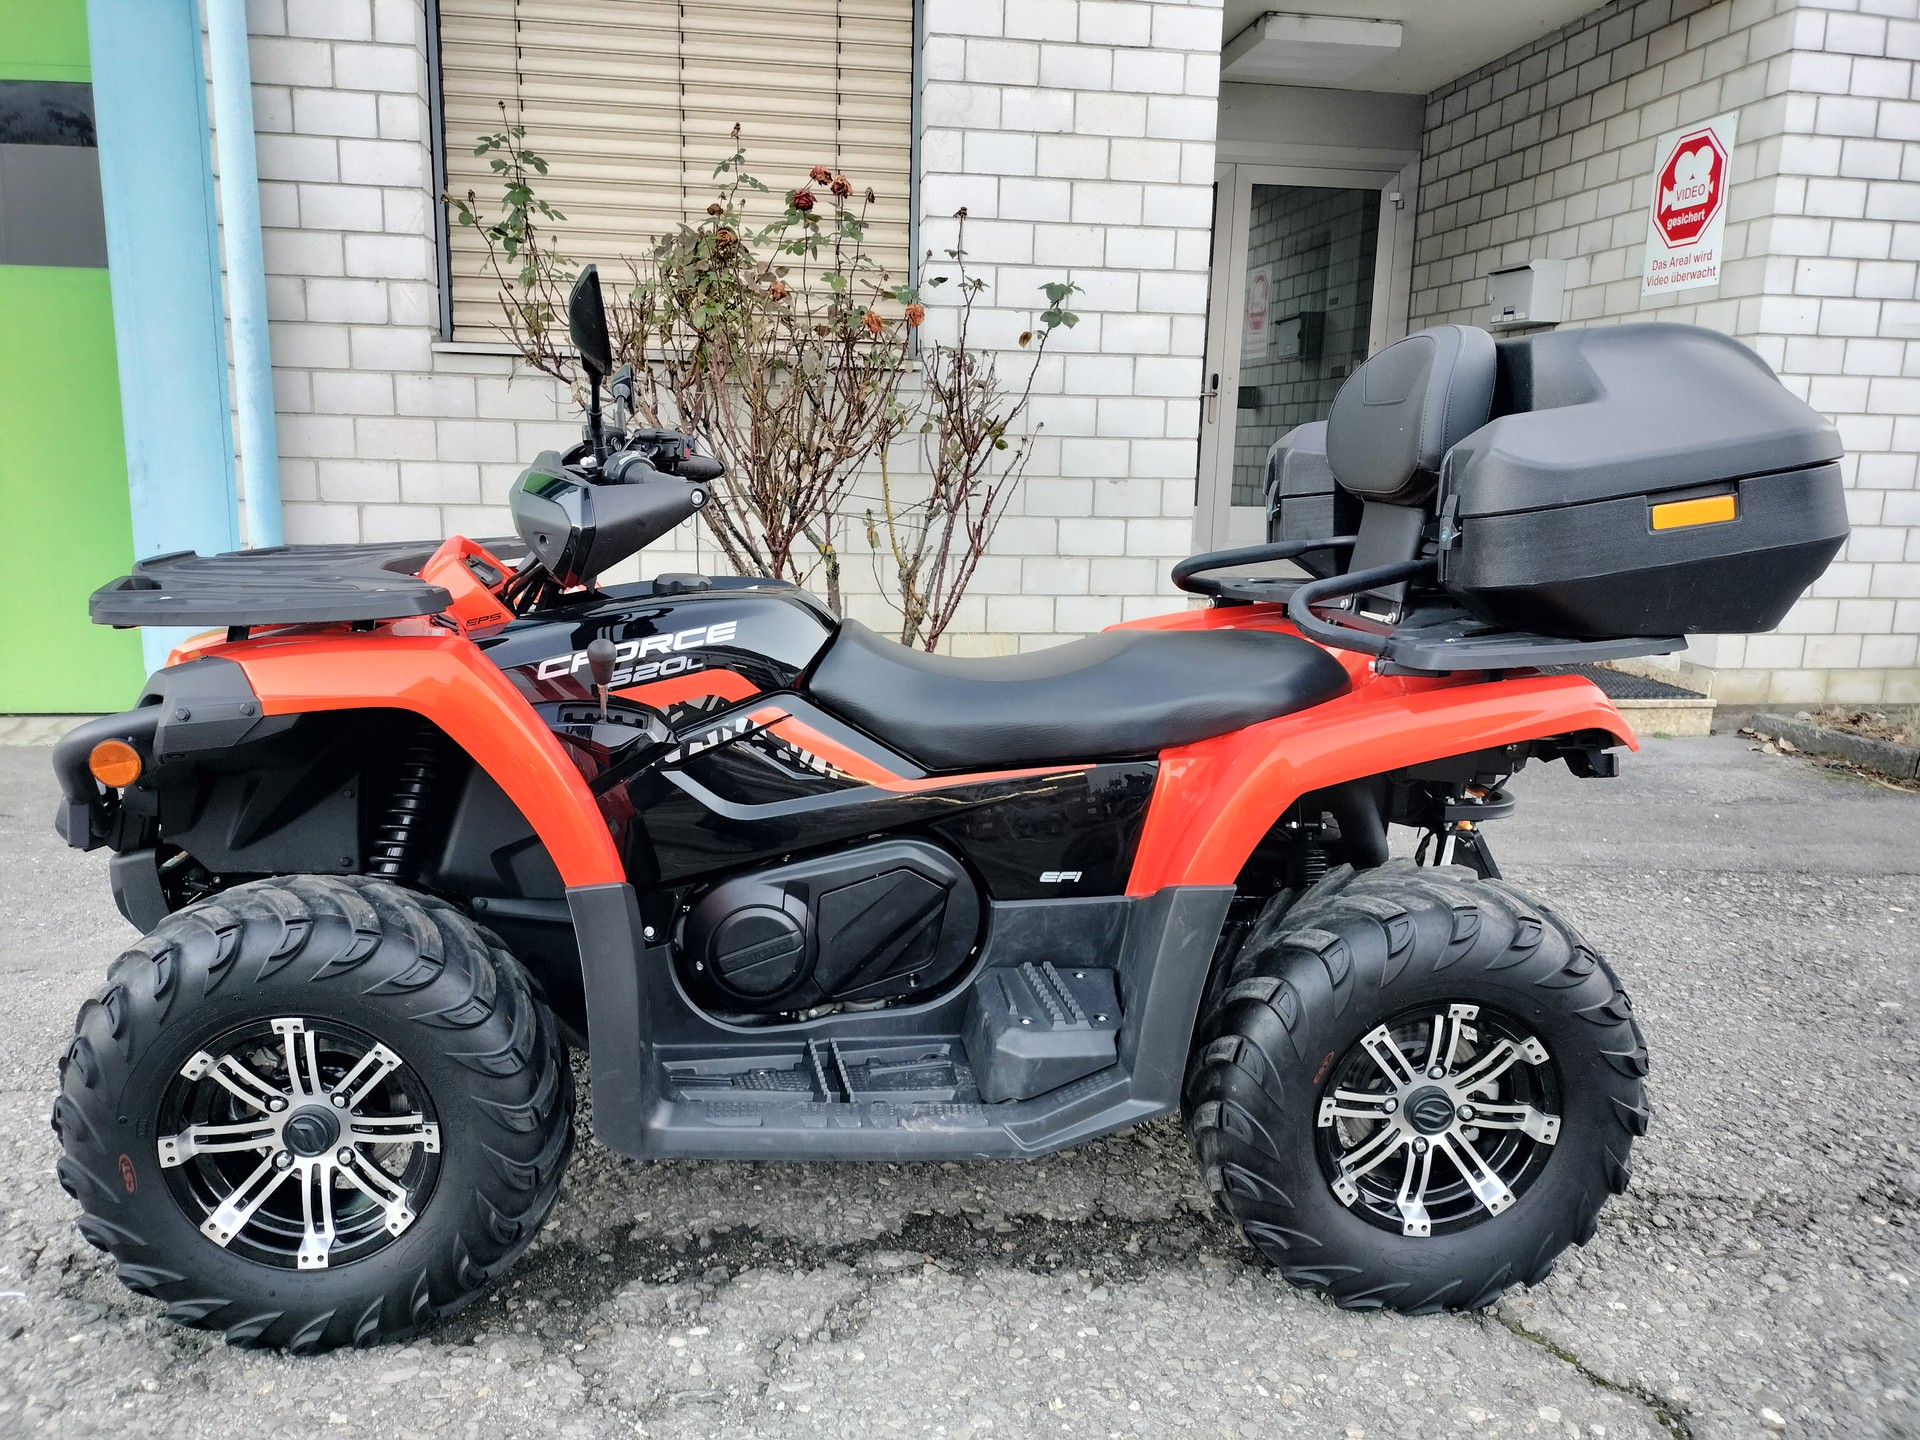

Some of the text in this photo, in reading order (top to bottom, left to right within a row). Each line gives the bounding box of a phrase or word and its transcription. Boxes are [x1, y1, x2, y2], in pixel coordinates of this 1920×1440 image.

[1676, 183, 1706, 201] VIDEO
[1667, 209, 1705, 230] gesichert
[1652, 249, 1713, 271] Das Areal wird
[1646, 265, 1716, 288] Video überwacht
[466, 612, 502, 627] EPS
[1039, 871, 1083, 883] EFI
